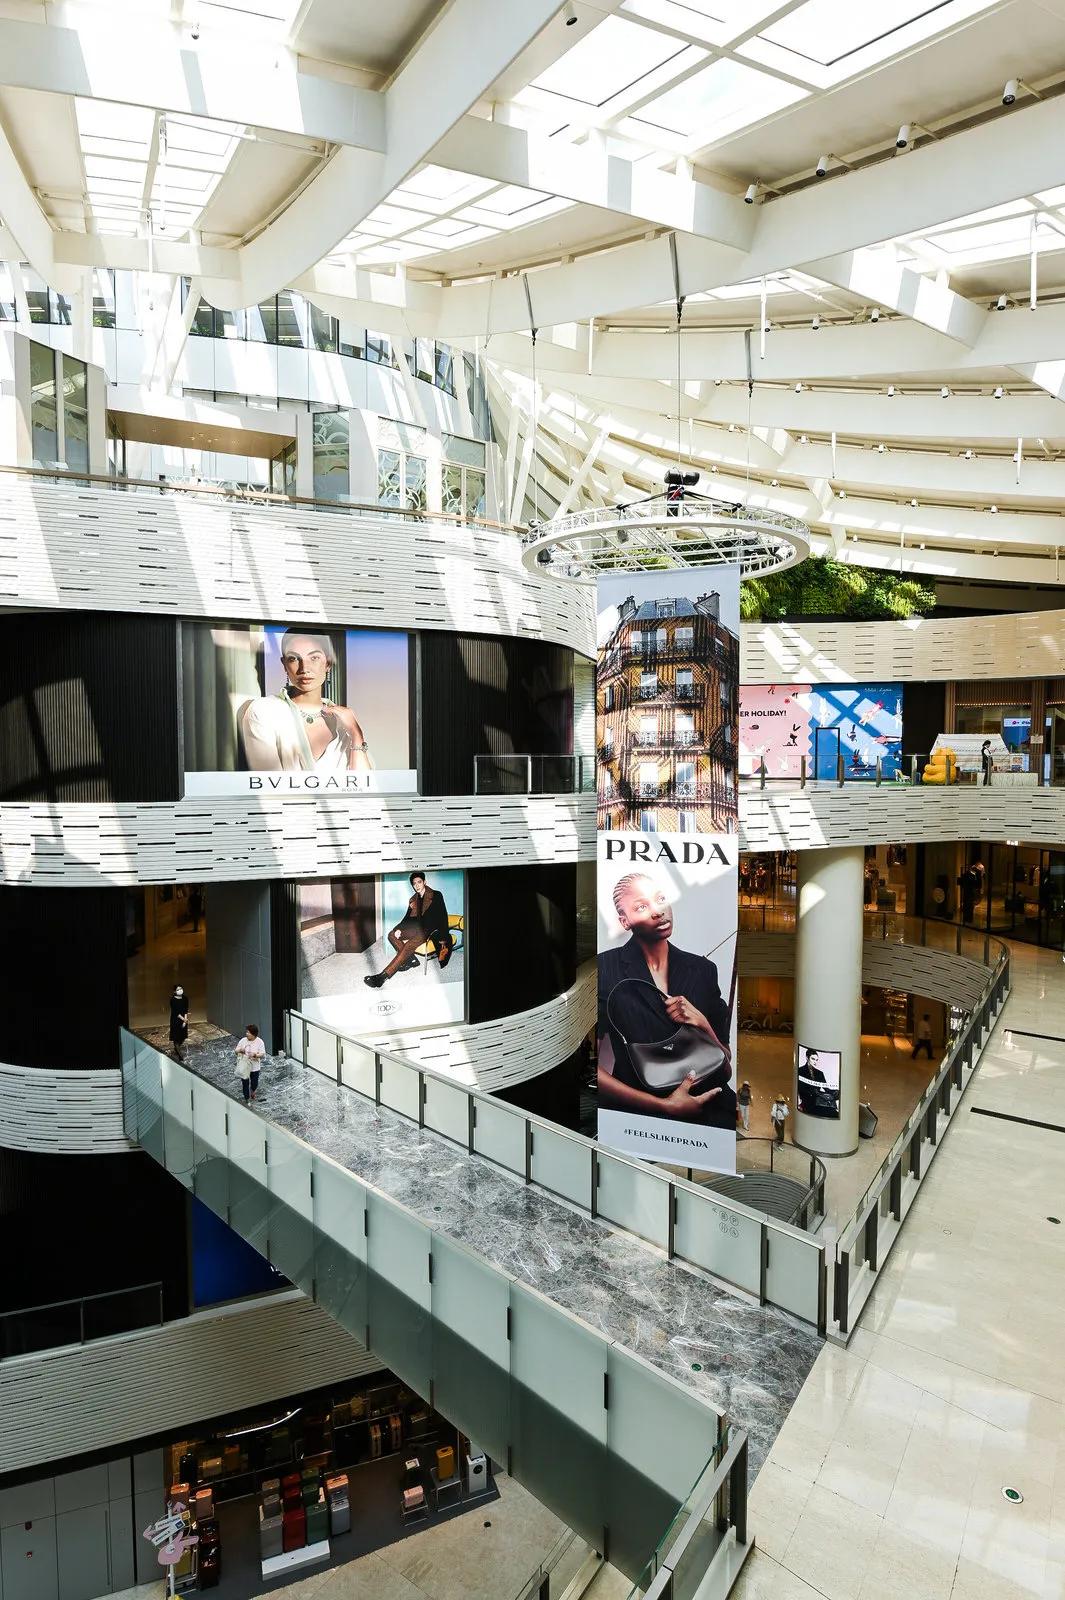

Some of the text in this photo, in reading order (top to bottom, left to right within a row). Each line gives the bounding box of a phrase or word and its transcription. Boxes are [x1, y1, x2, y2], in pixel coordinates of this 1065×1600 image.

[249, 776, 370, 789] BVLGARI
[606, 839, 731, 865] PRADA
[624, 1129, 708, 1149] #FEELSLIKEPRADA
